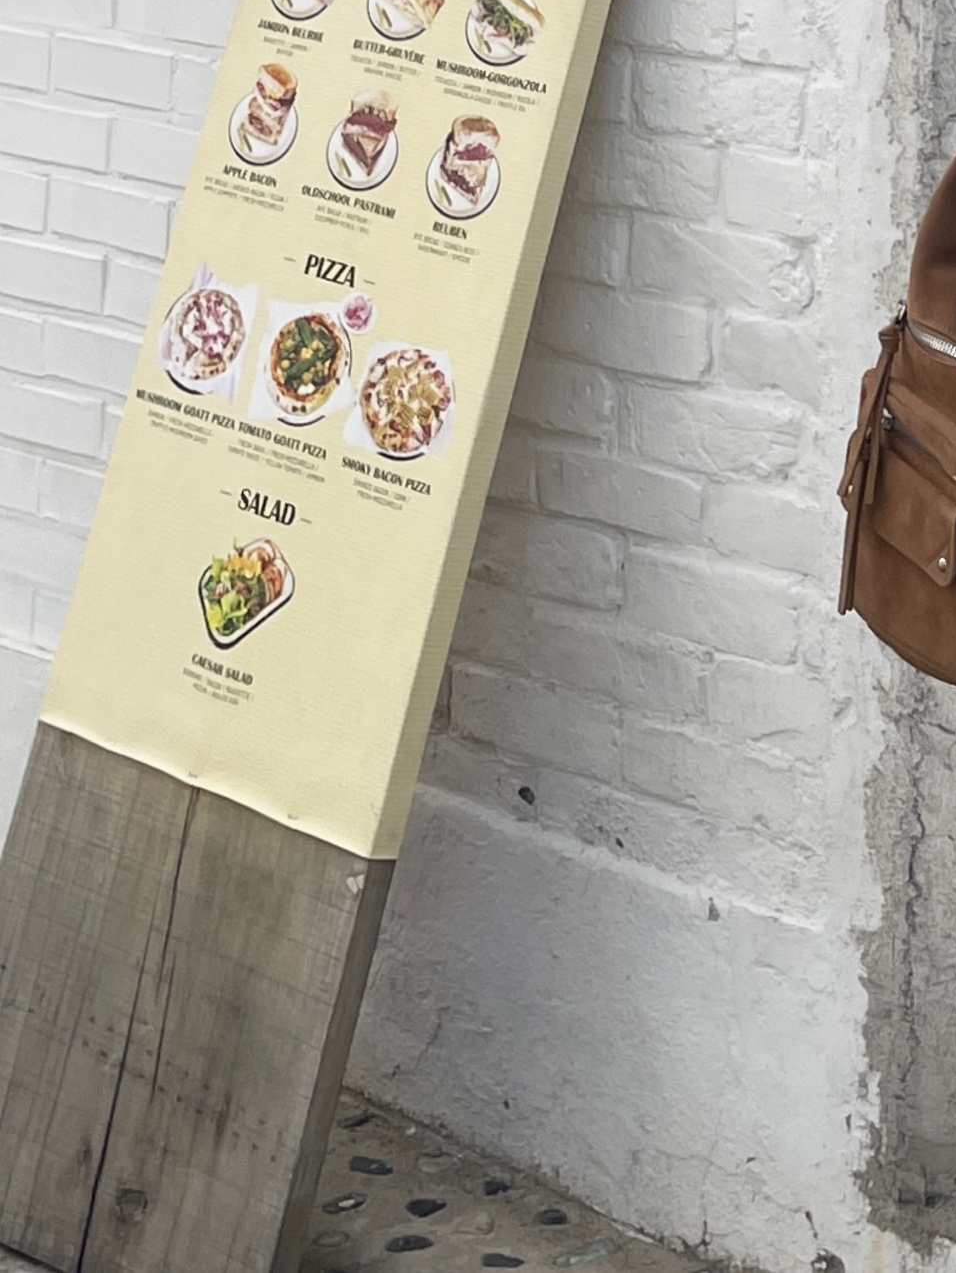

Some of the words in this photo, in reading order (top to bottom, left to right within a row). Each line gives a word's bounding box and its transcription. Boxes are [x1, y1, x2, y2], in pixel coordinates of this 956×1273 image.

[223, 164, 248, 181] APPLE
[249, 171, 278, 188] BACON
[432, 221, 468, 240] REUBEN
[304, 253, 356, 288] PIZZA
[136, 389, 182, 412] MUSHROOM
[211, 413, 236, 430] PIZZA
[239, 421, 272, 441] TOMATO
[302, 442, 327, 460] PIZZA
[342, 456, 371, 476] SMOKY
[373, 466, 403, 487] BACON
[405, 478, 432, 496] PIZZA
[237, 488, 297, 527] SALAD
[191, 653, 224, 676] CAESAR
[225, 667, 254, 686] SALAD
